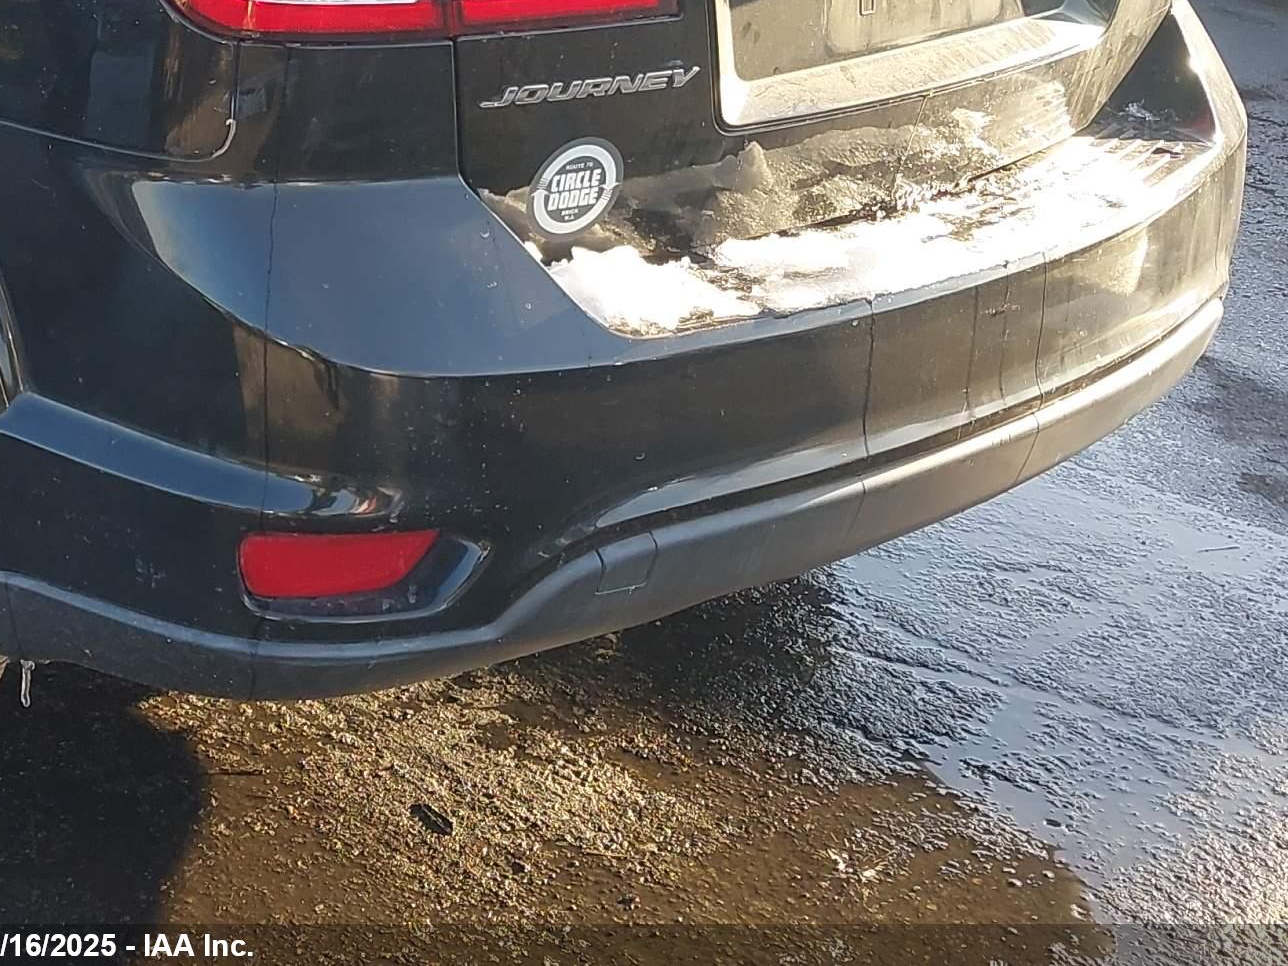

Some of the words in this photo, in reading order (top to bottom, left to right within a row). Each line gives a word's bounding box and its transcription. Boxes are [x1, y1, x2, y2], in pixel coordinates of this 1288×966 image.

[479, 66, 701, 109] JOURNEY
[551, 168, 602, 192] CIRCLE
[547, 186, 599, 211] DODGE
